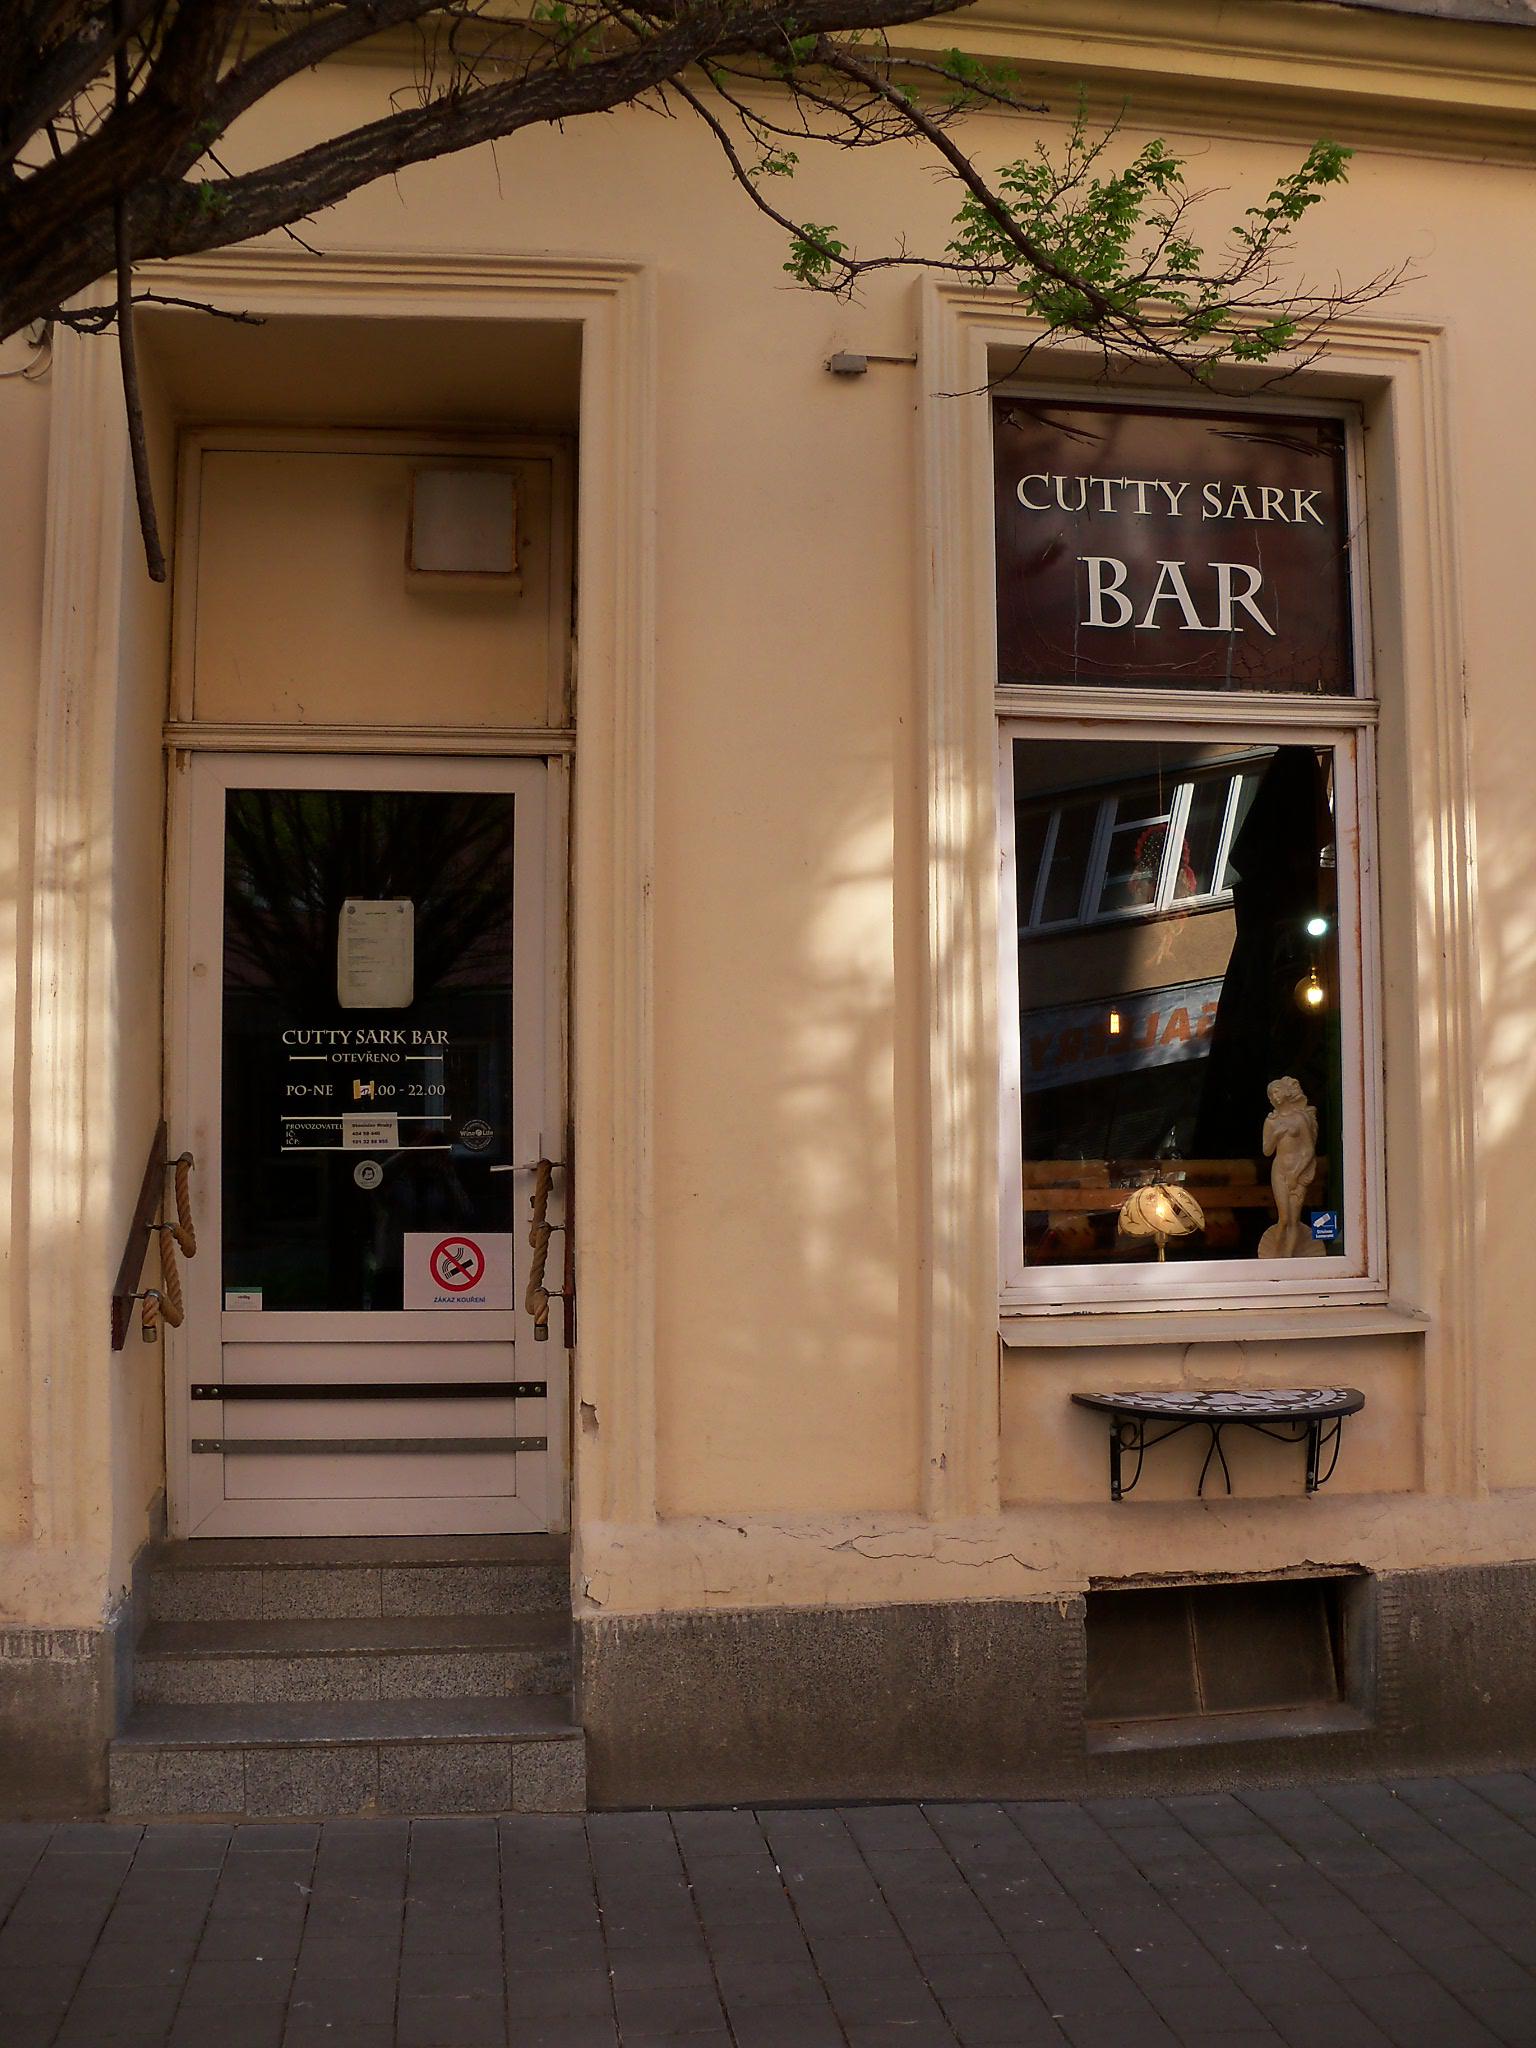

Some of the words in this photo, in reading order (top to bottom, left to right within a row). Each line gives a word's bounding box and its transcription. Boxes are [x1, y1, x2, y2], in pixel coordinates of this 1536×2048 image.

[1016, 472, 1190, 516] CUTTY
[1202, 481, 1325, 525] SARK
[1076, 556, 1277, 636] BAR
[282, 1029, 352, 1045] CUTTY
[355, 1029, 408, 1046] SARK
[411, 1030, 450, 1045] BAR
[331, 1050, 400, 1063] OTEVŘENO
[286, 1084, 333, 1096] PO-NE
[408, 1084, 446, 1096] 22.00
